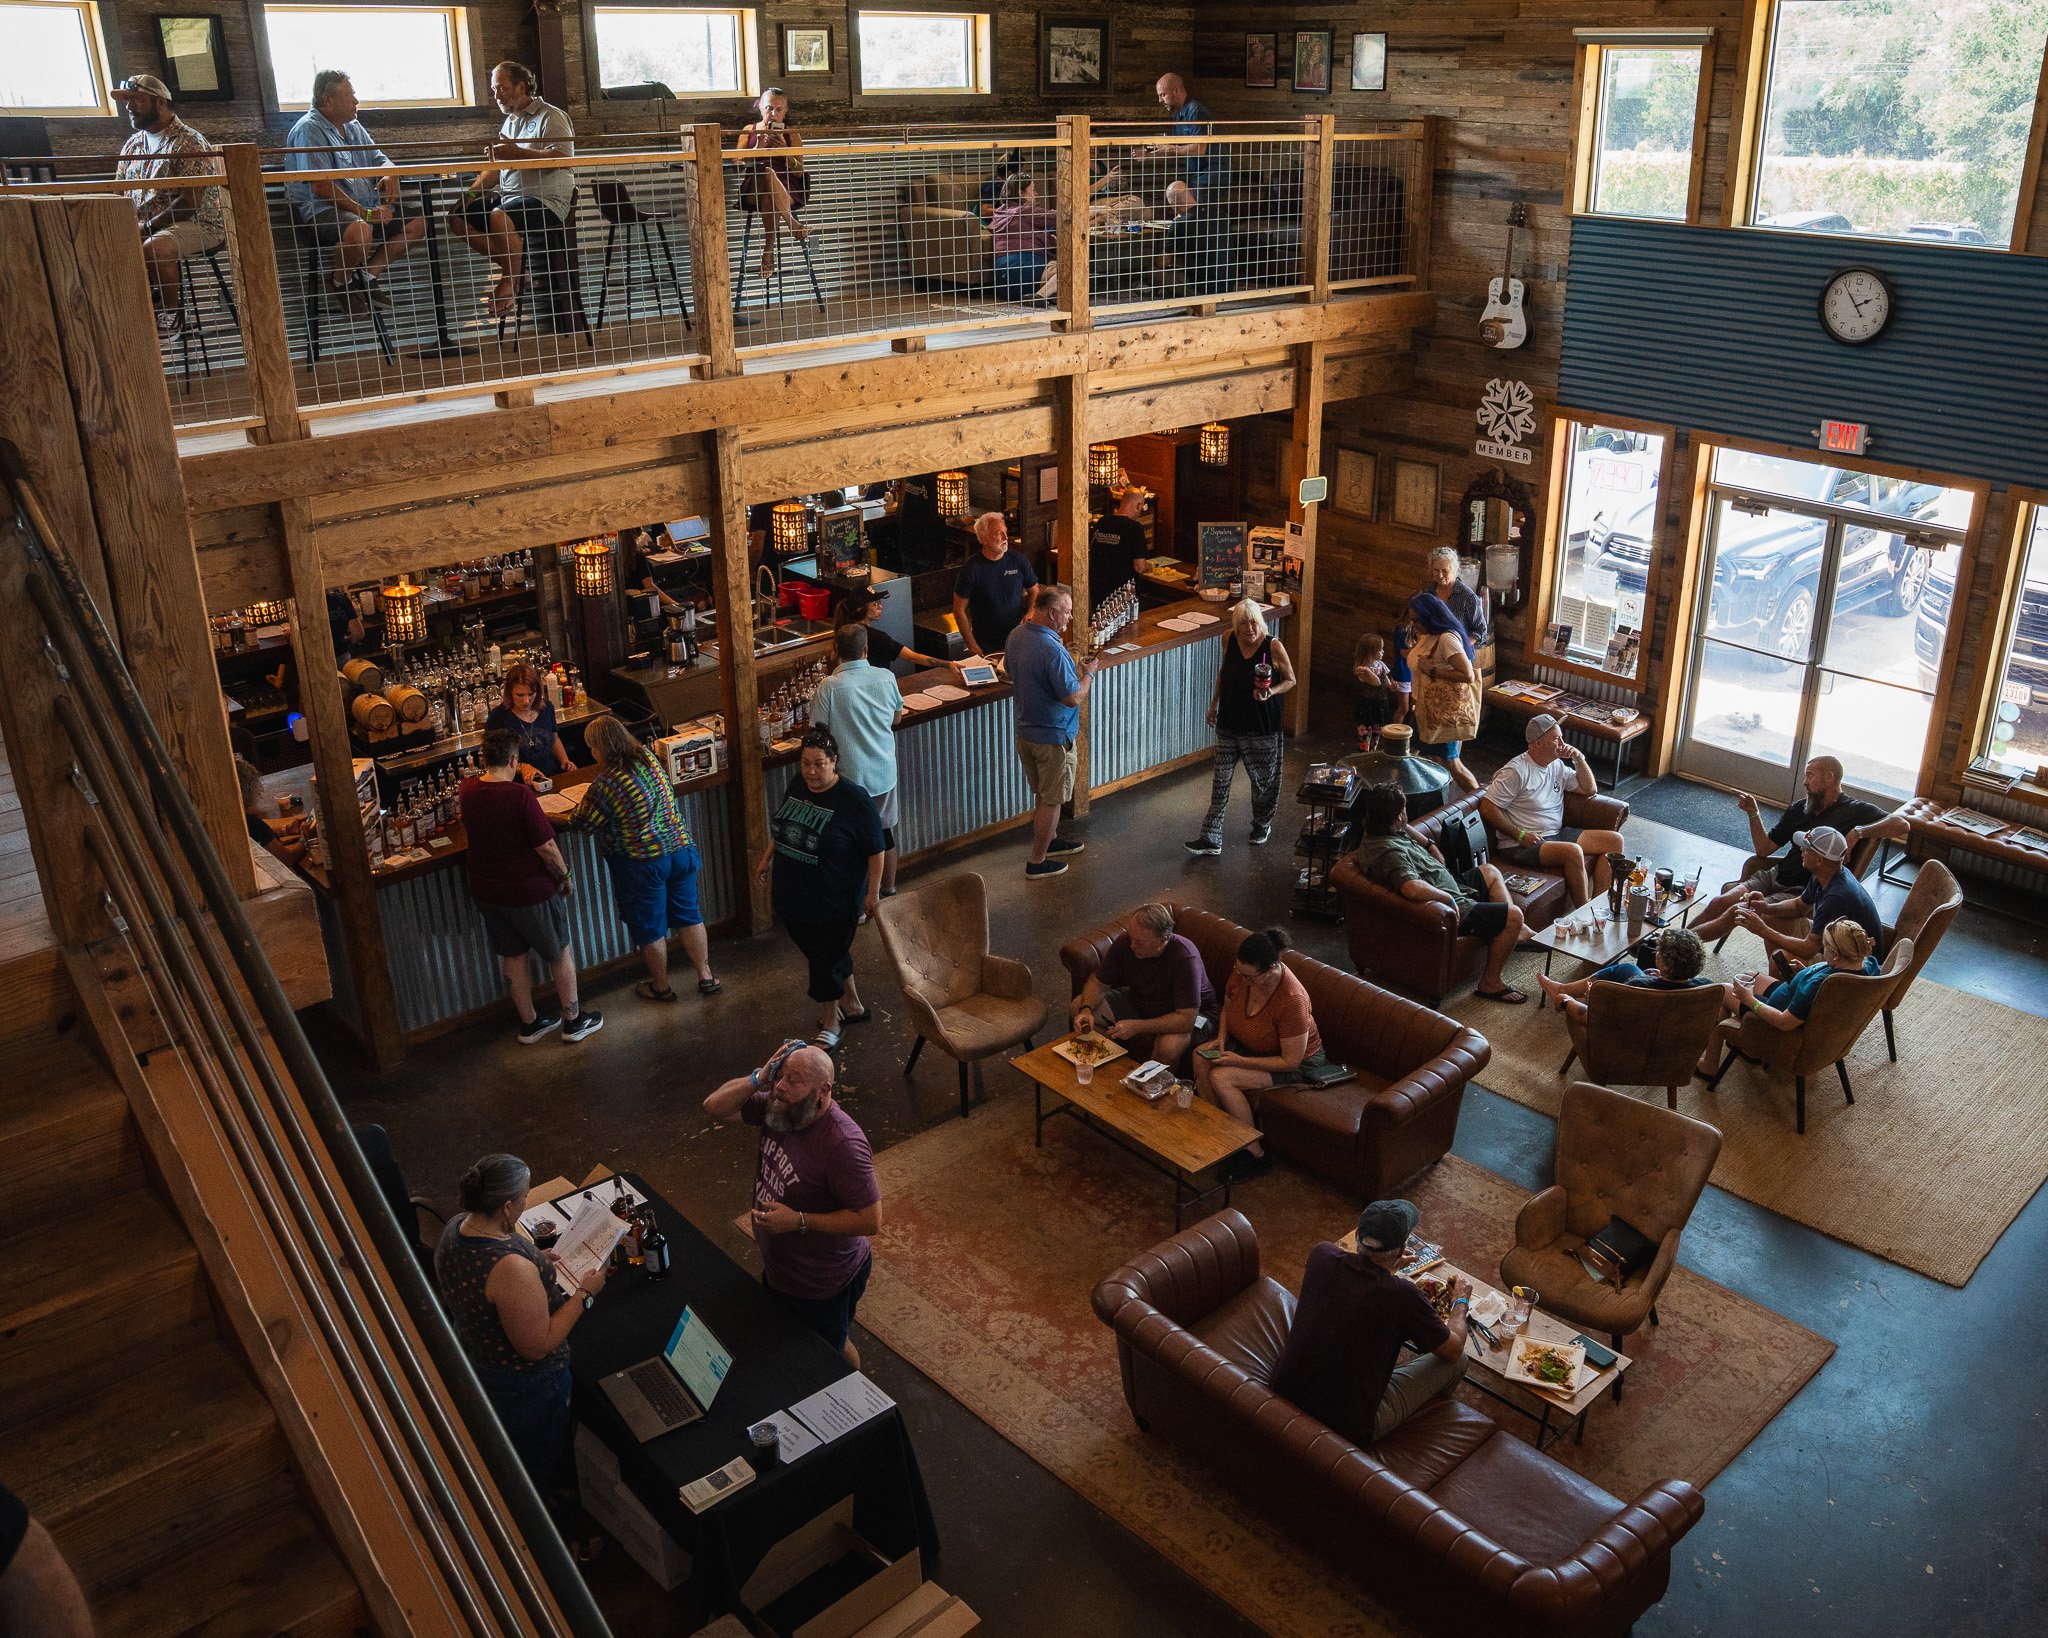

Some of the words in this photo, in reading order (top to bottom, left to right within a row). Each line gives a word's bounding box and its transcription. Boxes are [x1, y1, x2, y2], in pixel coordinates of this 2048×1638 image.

[1298, 35, 1310, 43] LIFE
[1827, 421, 1860, 451] EXIT
[1478, 444, 1529, 461] MEMBER
[774, 799, 834, 835] EVERETT
